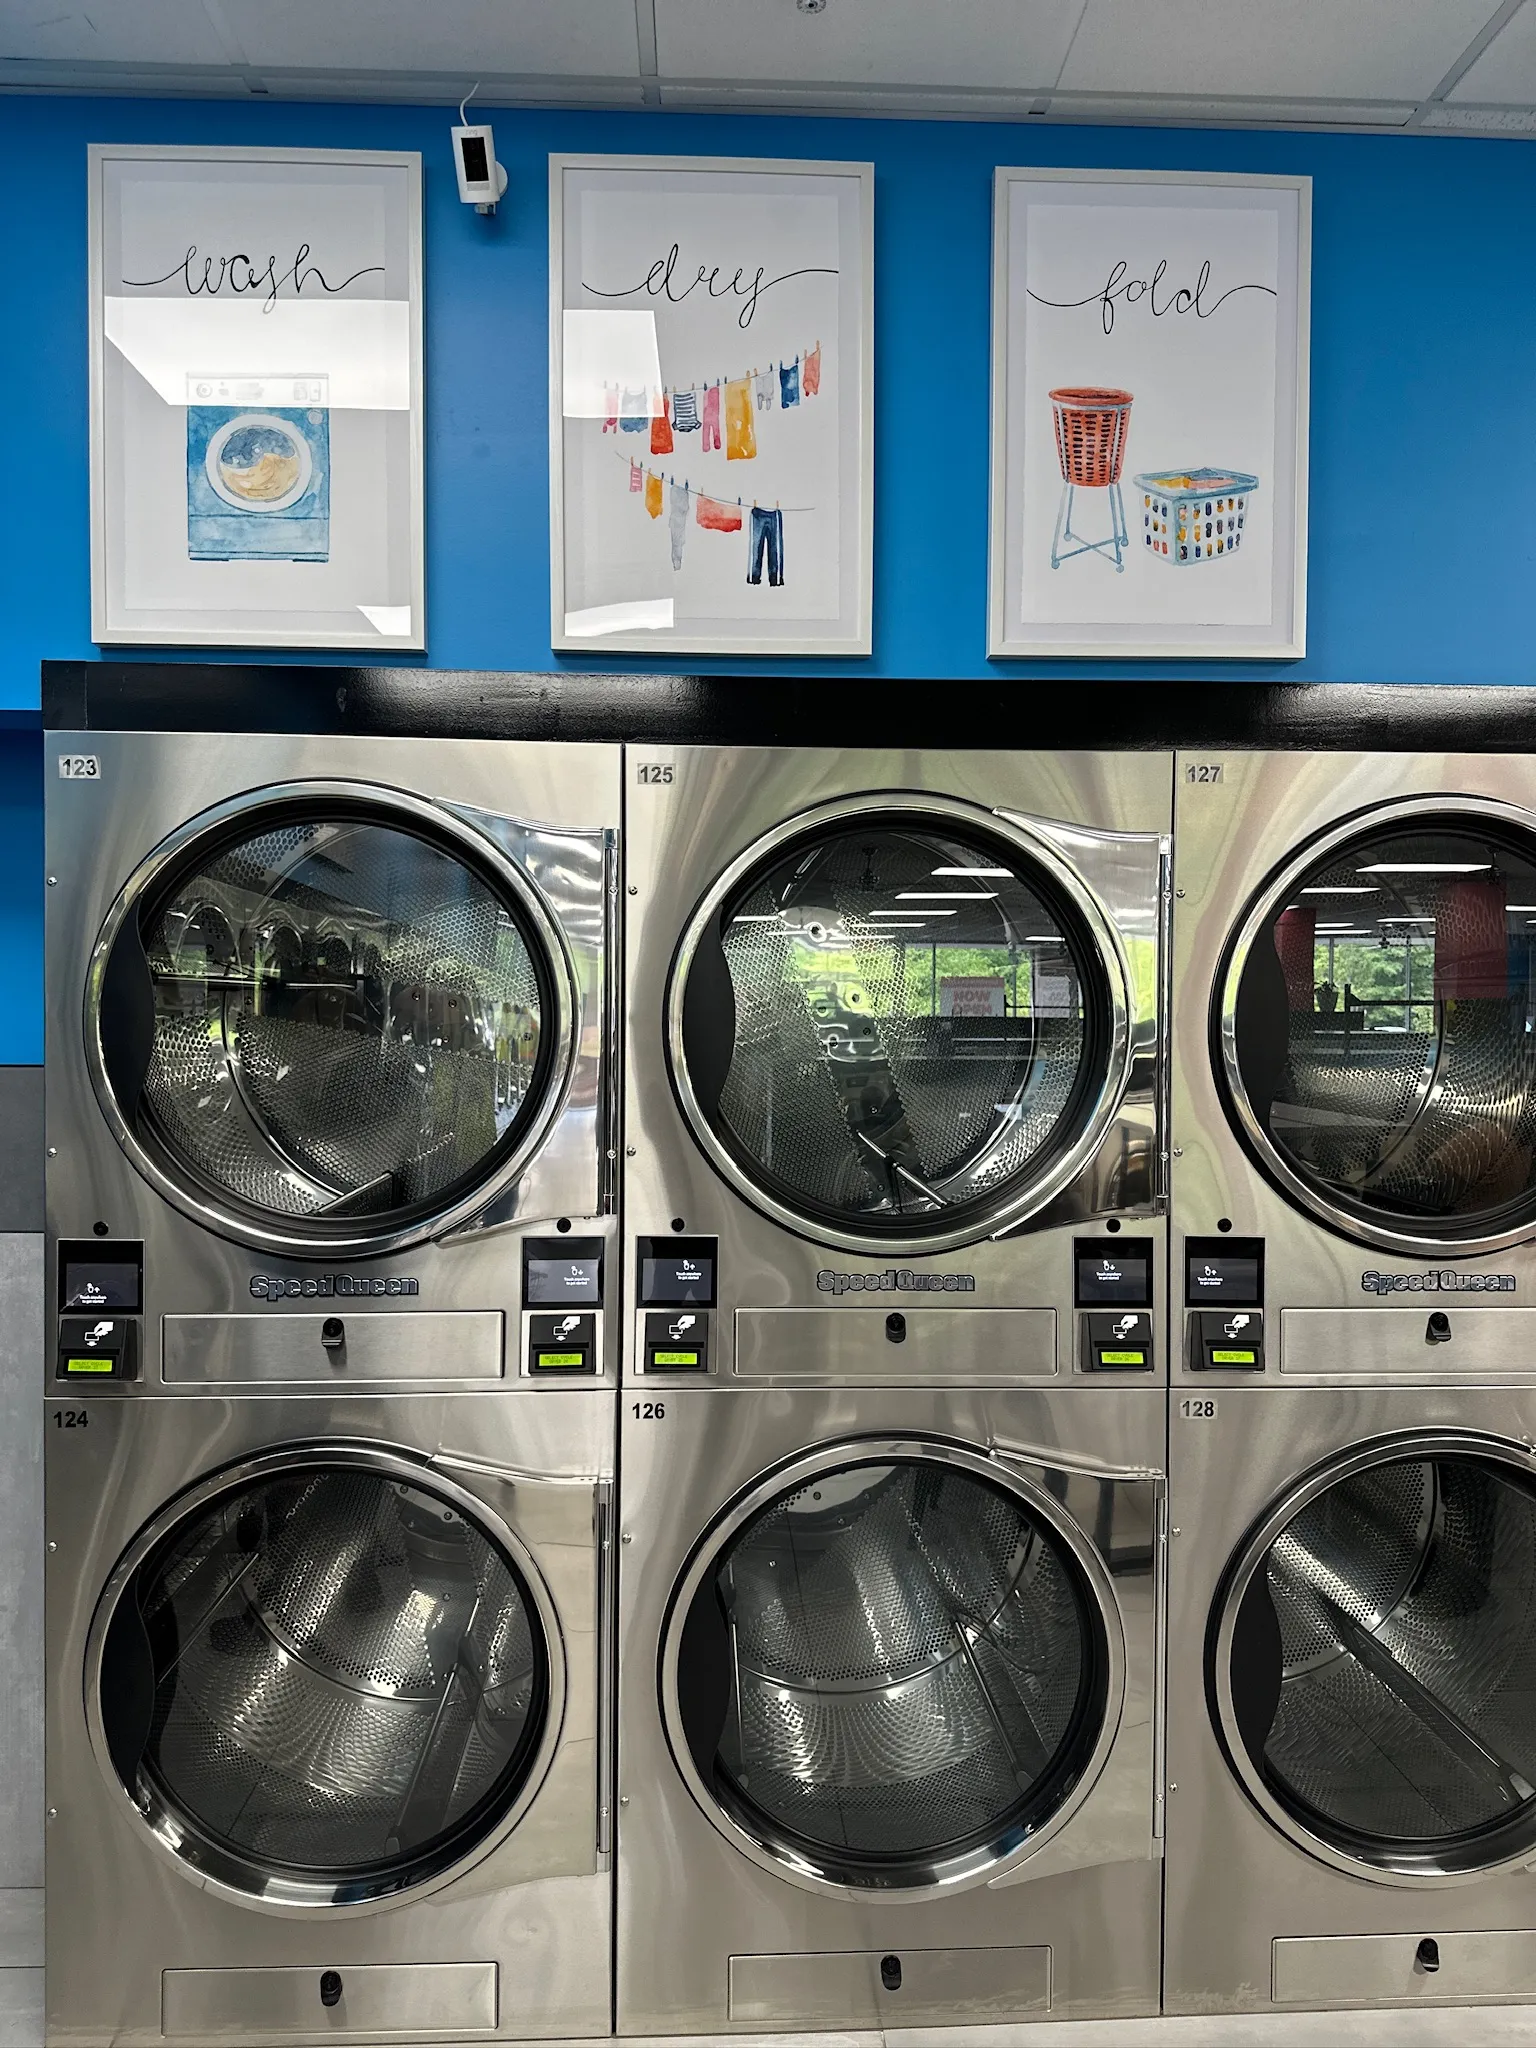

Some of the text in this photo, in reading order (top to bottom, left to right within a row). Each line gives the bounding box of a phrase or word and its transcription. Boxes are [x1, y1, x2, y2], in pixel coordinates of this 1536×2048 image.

[122, 243, 386, 315] wash
[581, 243, 839, 329] dry
[1026, 259, 1278, 335] fold
[63, 758, 97, 776] 123
[640, 766, 673, 783] 125
[1188, 765, 1221, 783] 127
[953, 991, 991, 1002] NOW
[632, 1402, 665, 1419] 126
[1182, 1400, 1214, 1417] 128
[53, 1410, 89, 1429] 124
